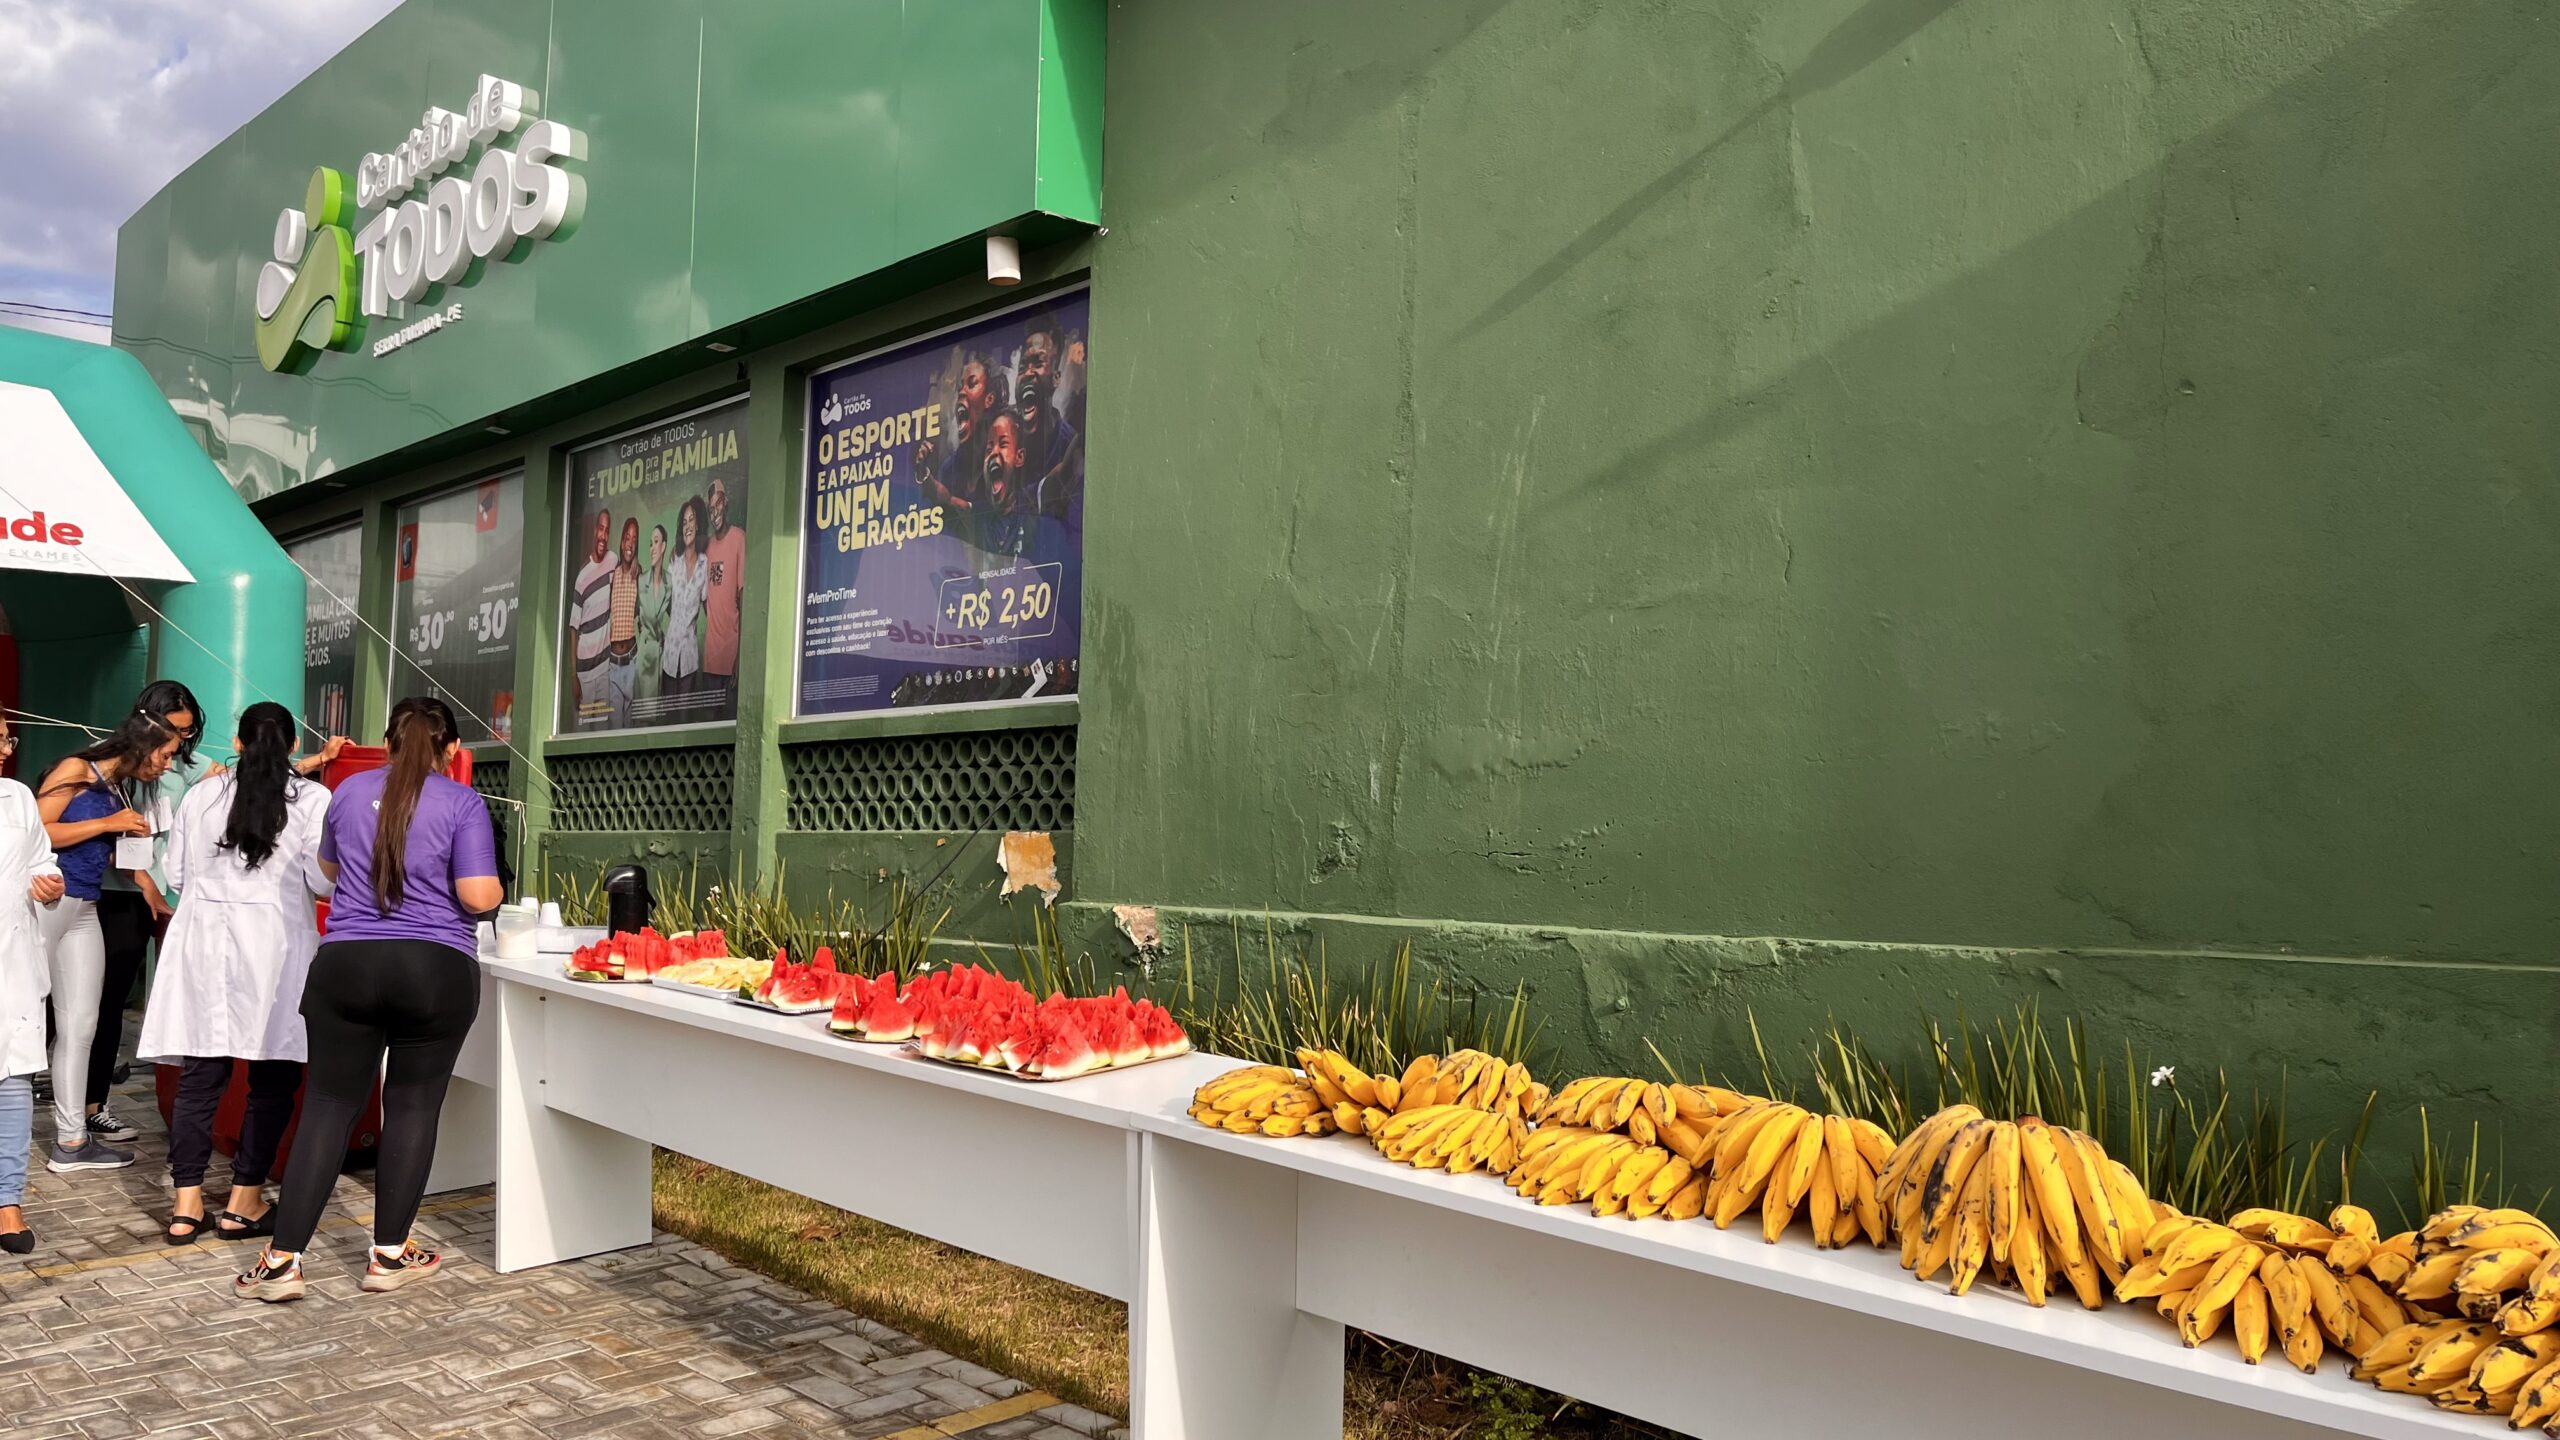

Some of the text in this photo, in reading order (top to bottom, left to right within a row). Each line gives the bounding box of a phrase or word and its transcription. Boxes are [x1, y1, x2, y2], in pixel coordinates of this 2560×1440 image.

[357, 73, 520, 208] Cartão de
[354, 119, 568, 317] TODOS
[844, 399, 872, 416] TODOS
[621, 422, 695, 458] Cartão de TODOS
[819, 403, 941, 465] O ESPORTE
[645, 455, 659, 470] pra
[661, 429, 739, 481] FAMÍLIA
[817, 452, 894, 492] E A PAIXÃO
[588, 458, 644, 498] É TUDO
[645, 470, 659, 485] sua
[816, 479, 890, 530] UNEM
[0, 510, 84, 546] de
[837, 503, 944, 553] GERAÇÕES
[9, 548, 81, 561] EXAMES
[978, 567, 1017, 580] MENSALIDADE
[306, 598, 334, 624] AMÍLIA
[807, 587, 857, 606] #VemProTime
[998, 582, 1052, 629] 2,50
[311, 626, 317, 645] E
[318, 619, 351, 644] MUITOS
